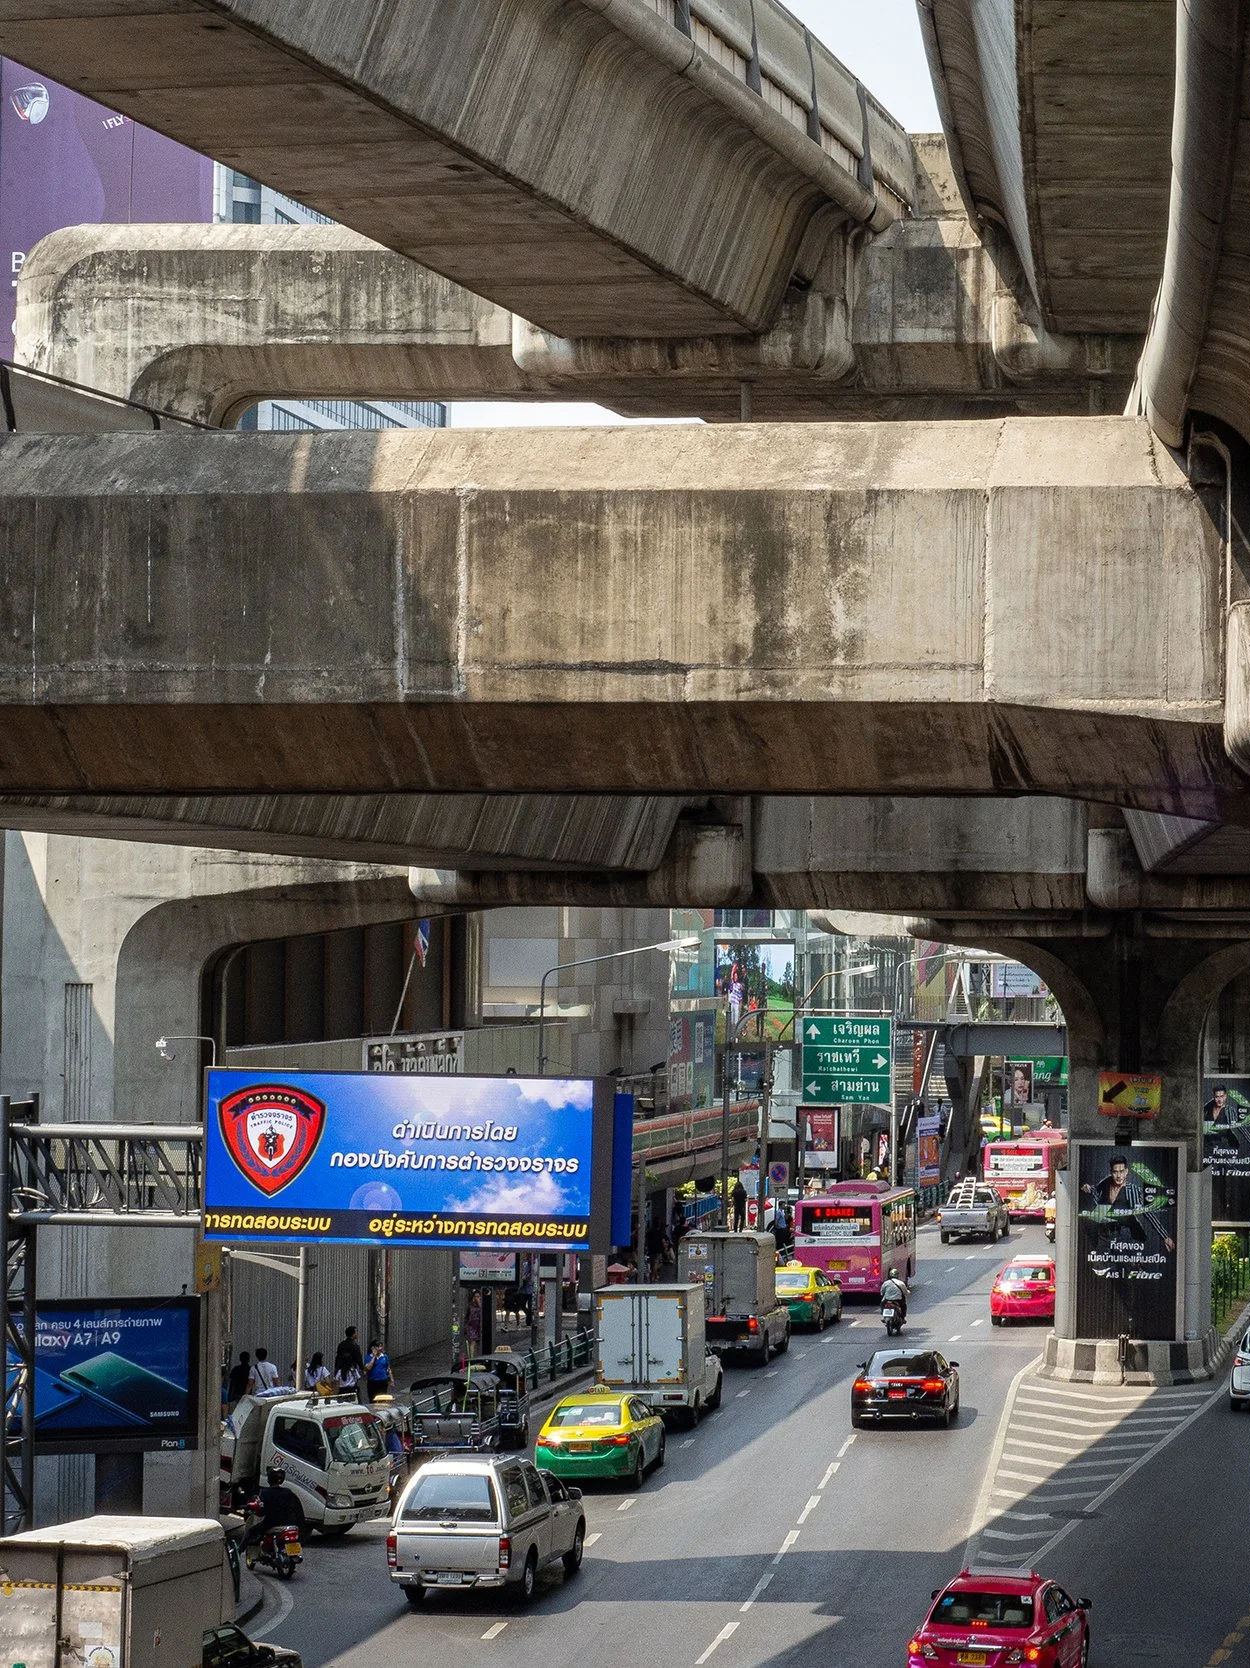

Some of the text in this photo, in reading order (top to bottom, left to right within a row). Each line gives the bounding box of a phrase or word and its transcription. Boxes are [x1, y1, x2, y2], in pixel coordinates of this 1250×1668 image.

[106, 114, 125, 129] FLY
[833, 1021, 880, 1037] เจริญผล
[816, 1048, 860, 1063] ราชเทวี
[831, 1078, 880, 1093] สามย่าน
[250, 1120, 294, 1130] TRAFFIC POLICE
[391, 1120, 519, 1142] ดำเนินการโดย
[329, 1150, 580, 1174] กองบังคับการตำรวจจราจร
[368, 1215, 588, 1239] อยู่ระหว่างการทดสอบระบบ
[1109, 1238, 1145, 1252] ที่สุดของ
[1128, 1270, 1163, 1280] Fibre
[51, 1320, 71, 1330] ครบ
[73, 1319, 81, 1329] 4
[73, 1332, 93, 1346] A7
[101, 1332, 121, 1345] A9
